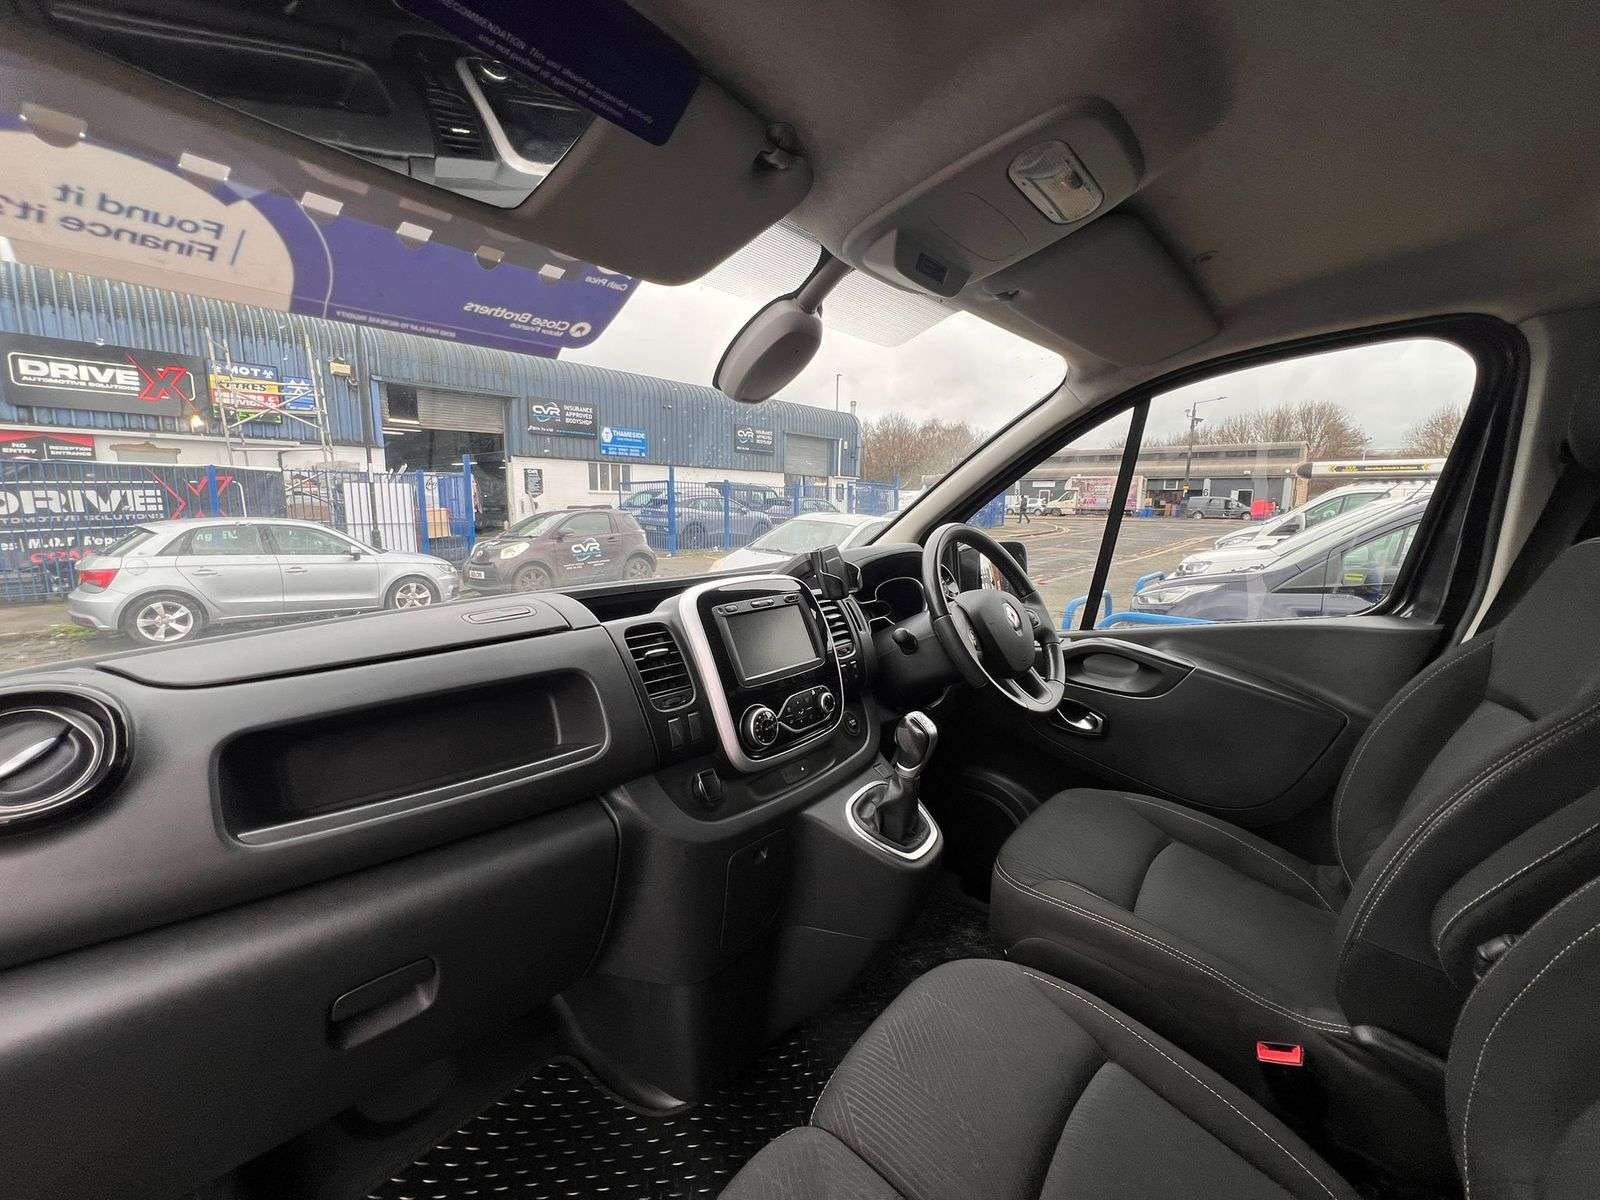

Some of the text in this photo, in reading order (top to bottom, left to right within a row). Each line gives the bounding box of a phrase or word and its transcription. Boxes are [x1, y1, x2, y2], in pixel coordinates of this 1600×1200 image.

[17, 358, 140, 386] DRIVE
[22, 375, 140, 392] AUTOMOTIVE SOLUTIONS
[532, 405, 560, 416] CVR
[564, 404, 593, 414] INSURANCE
[565, 411, 592, 420] APPROVED
[571, 542, 601, 553] CVR
